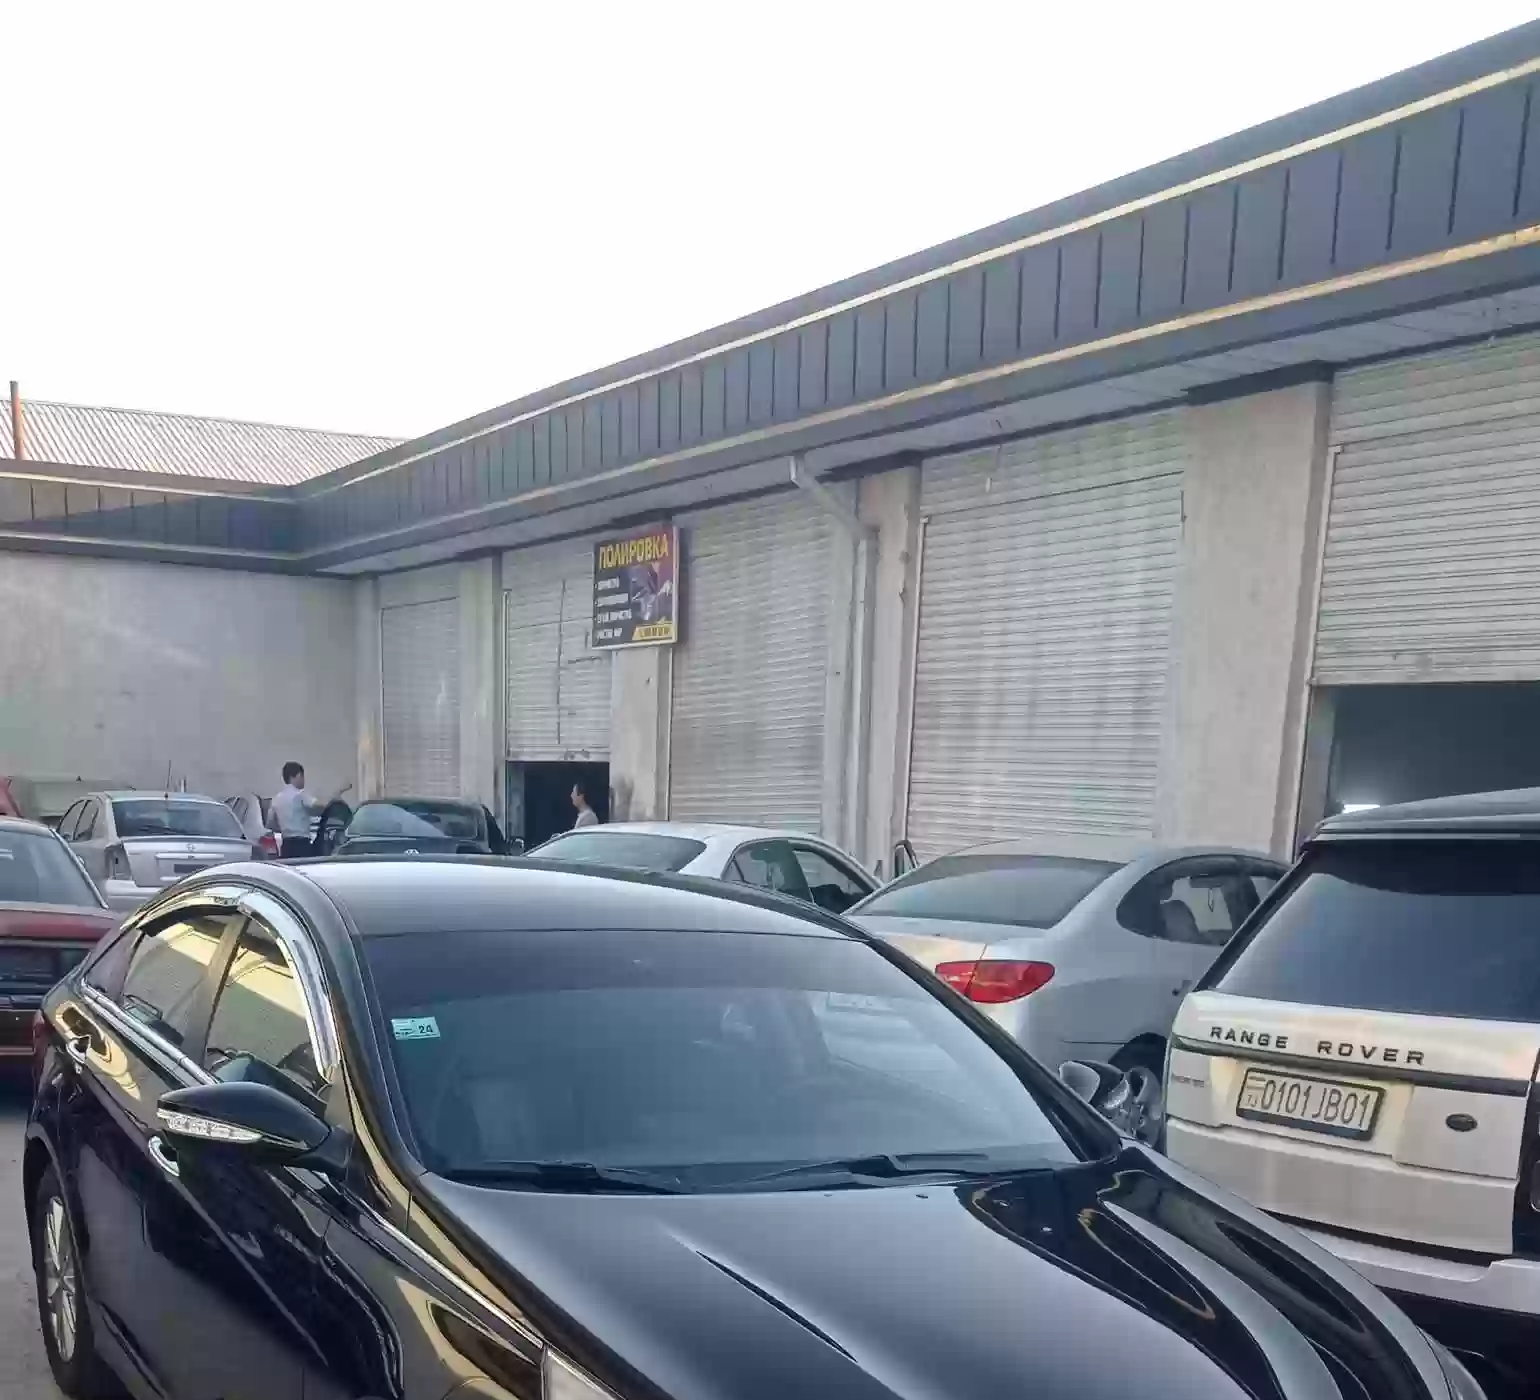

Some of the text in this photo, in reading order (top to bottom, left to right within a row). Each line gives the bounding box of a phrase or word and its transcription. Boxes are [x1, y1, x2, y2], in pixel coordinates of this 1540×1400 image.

[599, 533, 669, 569] ПОЛИРОВКА
[1210, 1026, 1425, 1066] RANGE ROVER
[1261, 1079, 1370, 1127] 0101JB01
